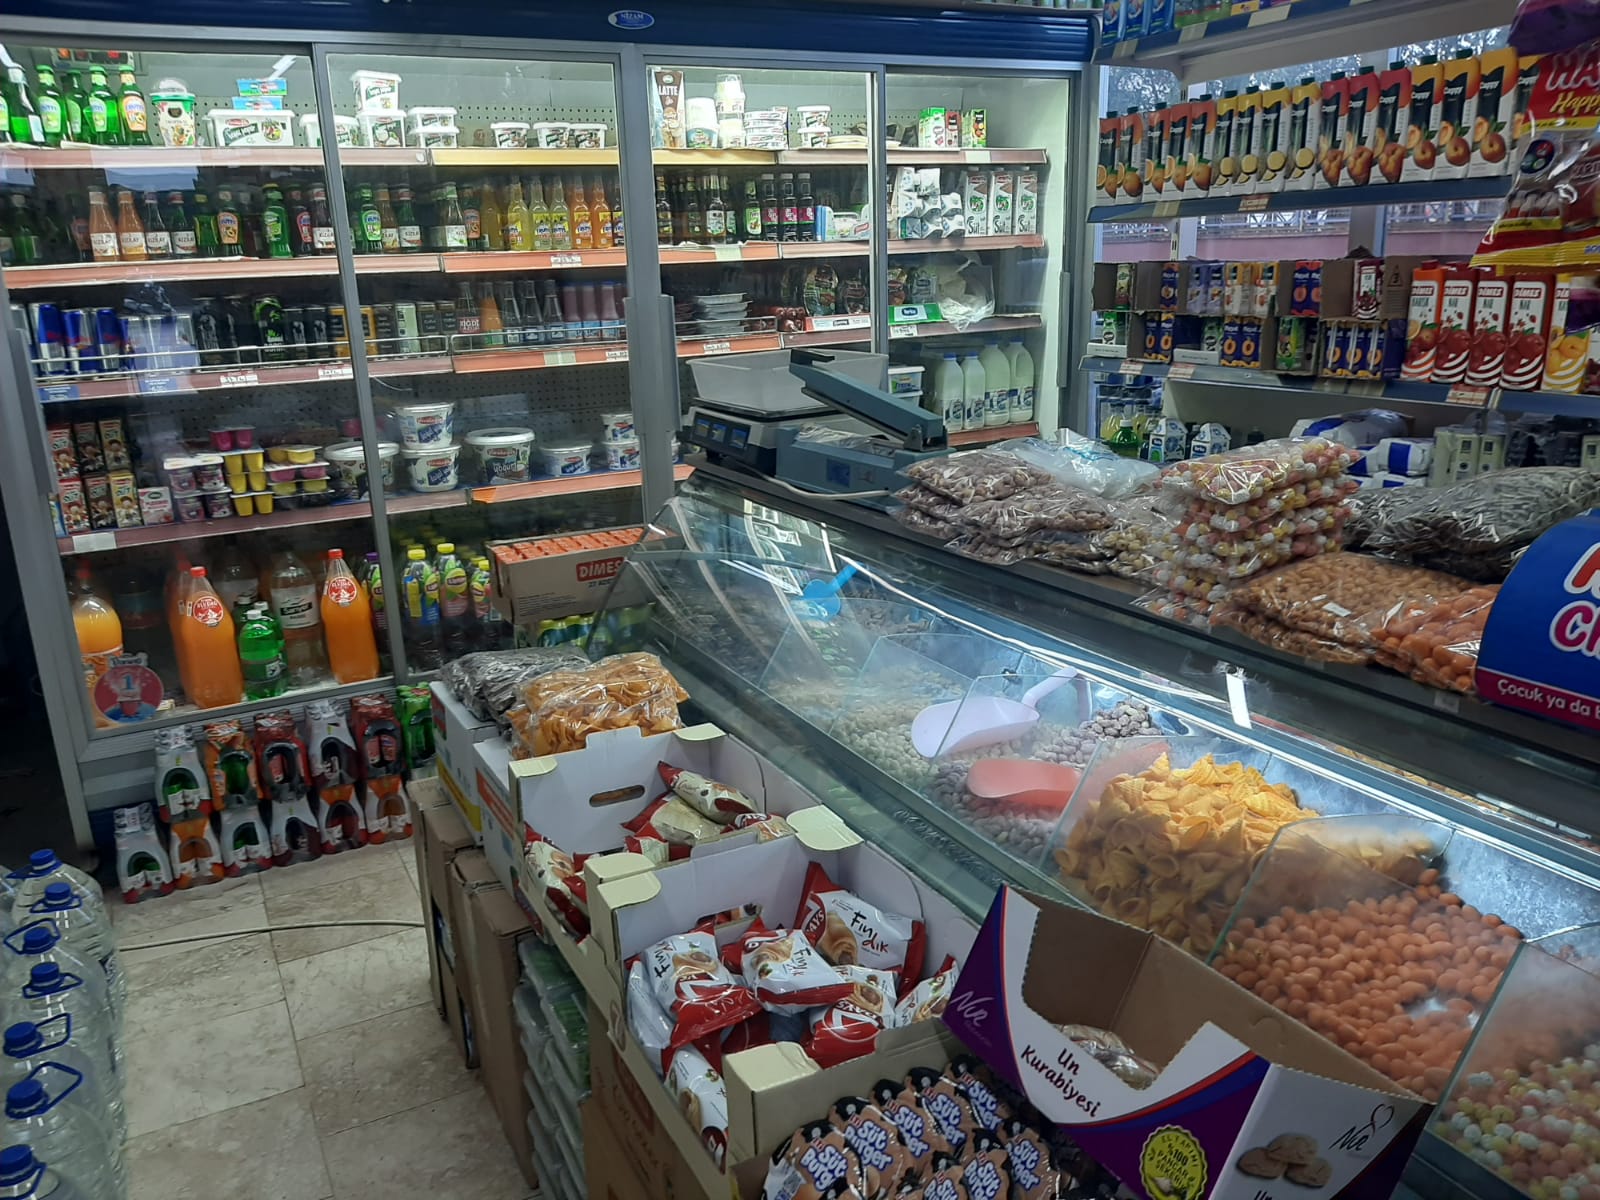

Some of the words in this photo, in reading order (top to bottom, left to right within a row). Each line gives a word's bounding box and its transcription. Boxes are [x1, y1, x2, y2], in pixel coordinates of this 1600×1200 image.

[658, 86, 679, 96] LATTE
[1550, 91, 1600, 117] Happ
[579, 559, 623, 578] DİMES
[1497, 677, 1544, 703] Çocuk
[1546, 693, 1566, 709] ya
[1570, 698, 1591, 716] da
[1058, 1048, 1080, 1076] Un
[1021, 1045, 1101, 1117] Kurabiyesi
[894, 1106, 923, 1137] Süt
[931, 1095, 960, 1127] Süt
[845, 1125, 892, 1170] Burger
[858, 1120, 887, 1150] Süt
[800, 1147, 836, 1190] Burg
[819, 1145, 847, 1177] Süt
[1014, 1140, 1039, 1169] Süt
[978, 1161, 1001, 1197] Süt
